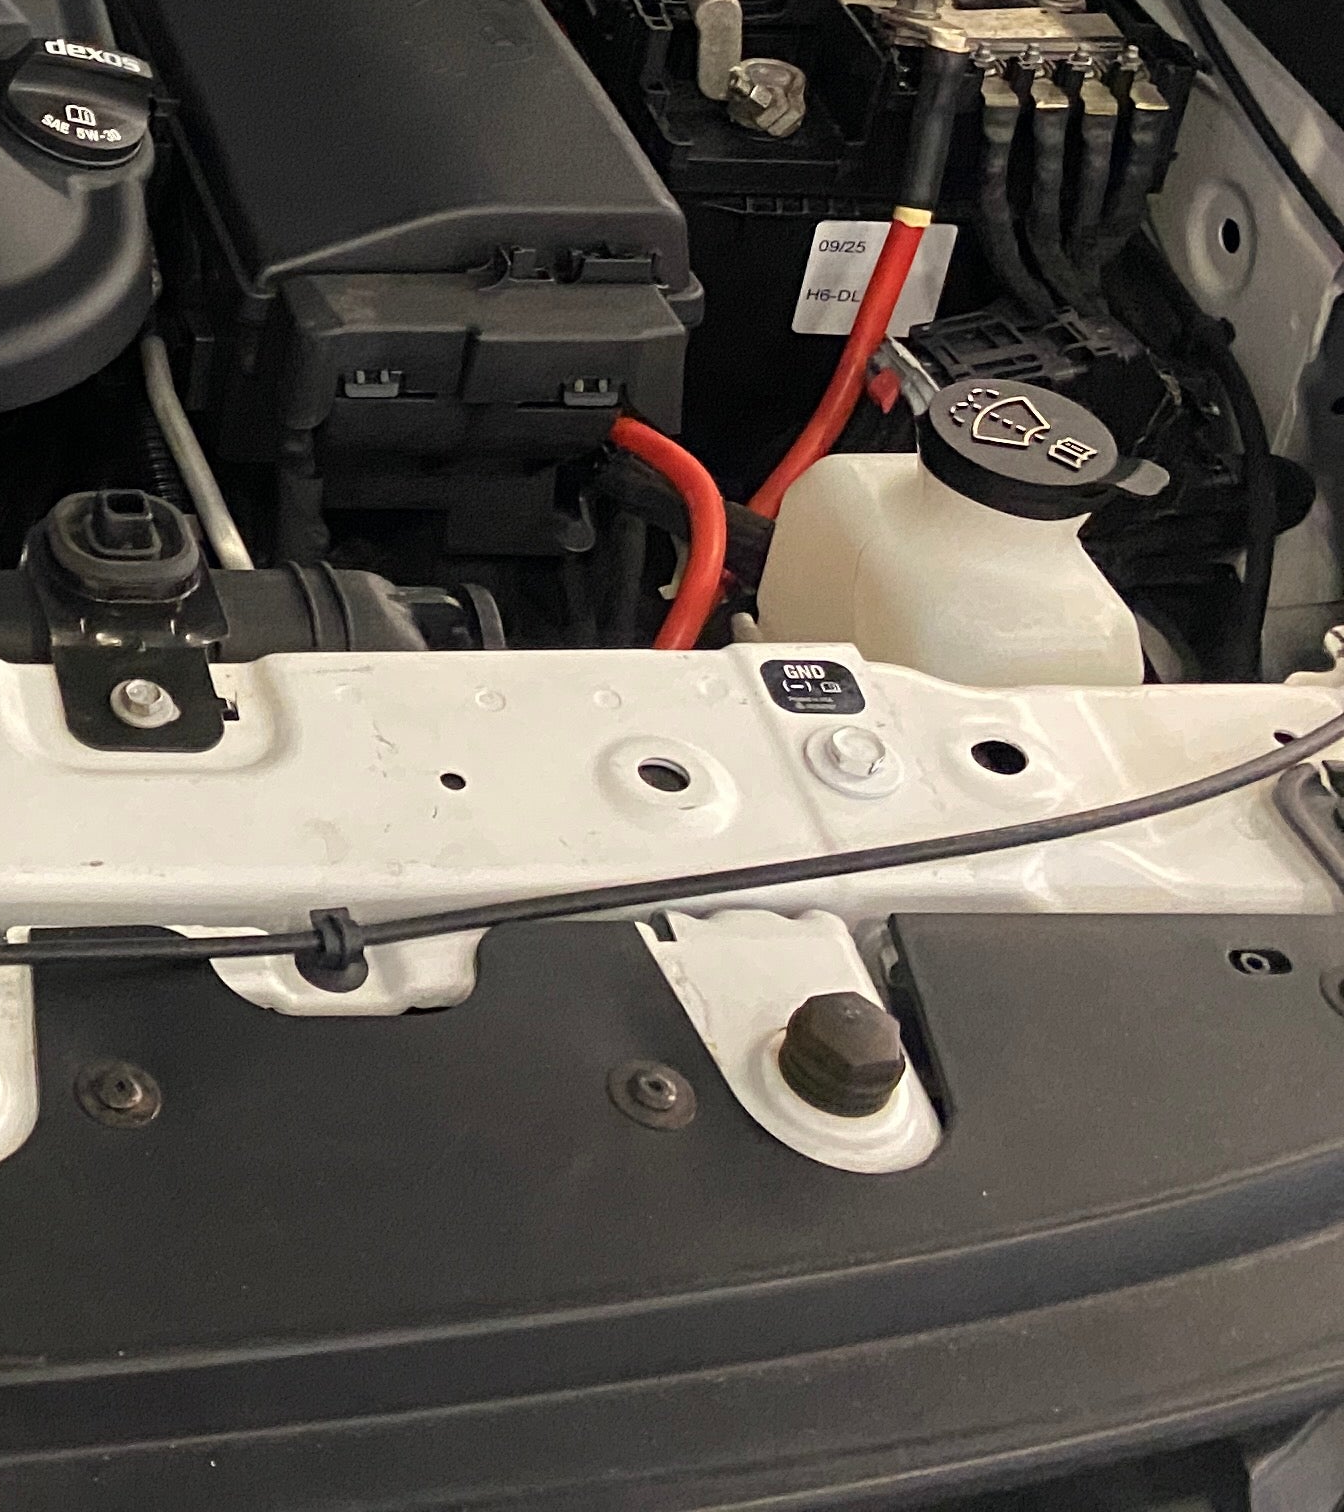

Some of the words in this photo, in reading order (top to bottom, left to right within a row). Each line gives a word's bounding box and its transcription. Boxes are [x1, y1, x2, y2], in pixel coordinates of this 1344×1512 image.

[44, 39, 140, 73] dexos
[41, 113, 70, 135] SAE
[818, 239, 867, 254] 09/25
[783, 664, 826, 679] GND
